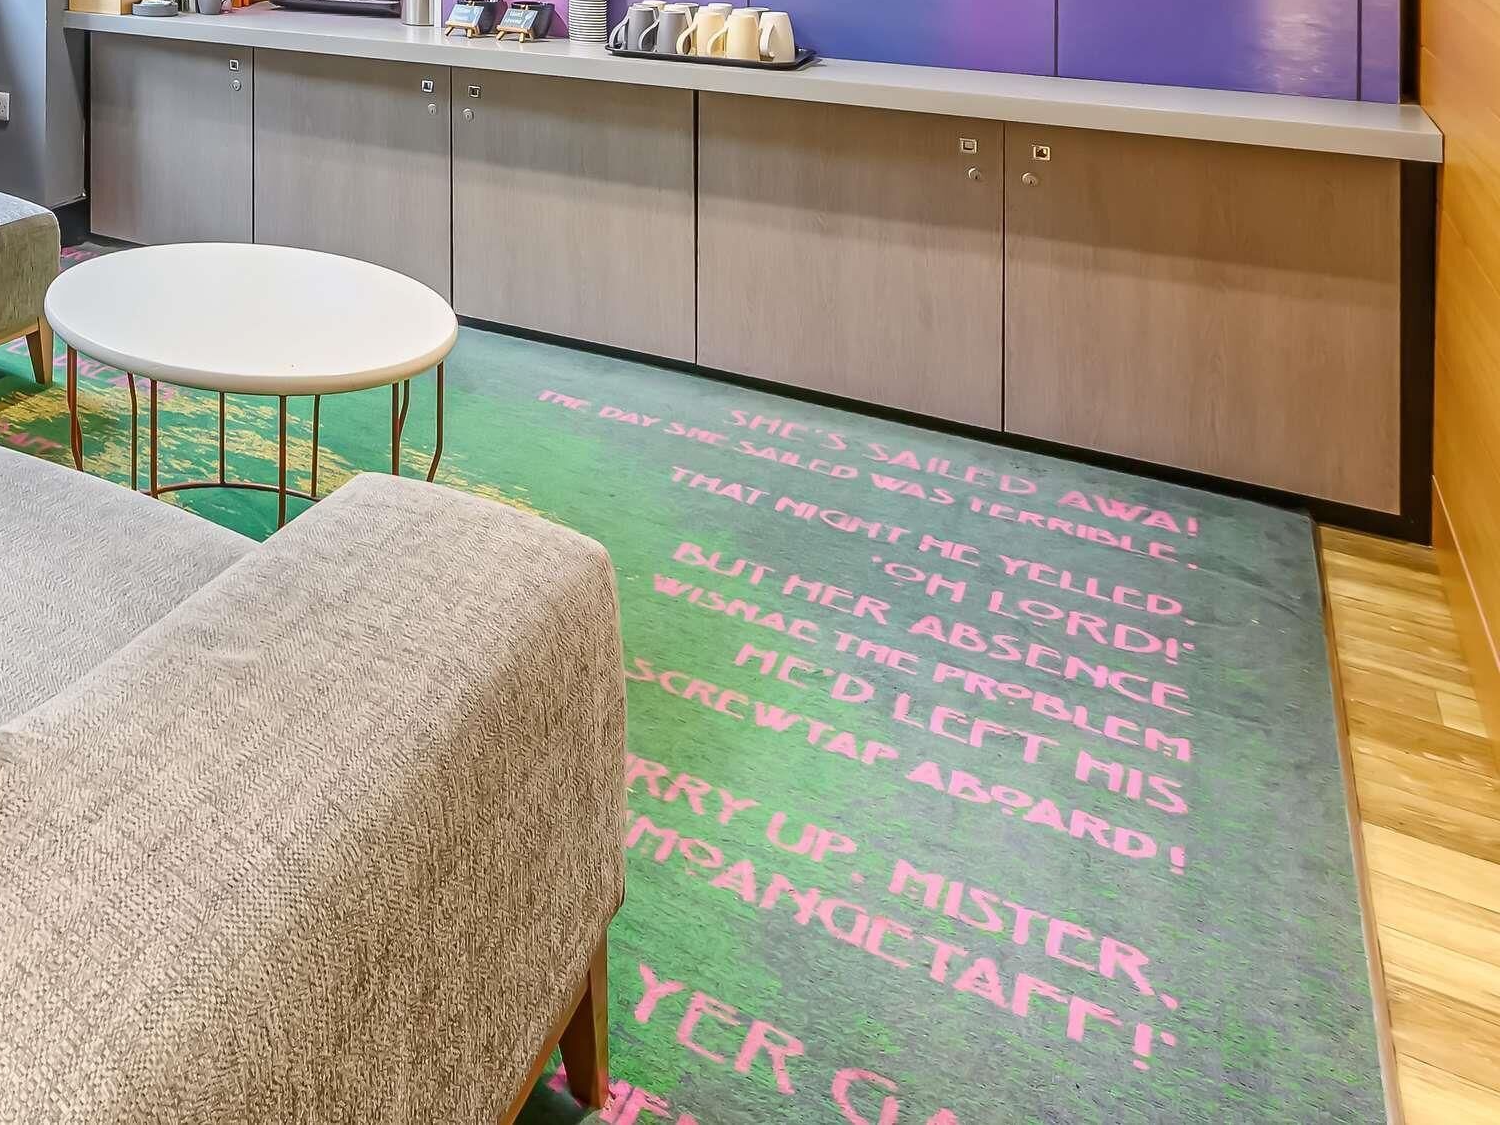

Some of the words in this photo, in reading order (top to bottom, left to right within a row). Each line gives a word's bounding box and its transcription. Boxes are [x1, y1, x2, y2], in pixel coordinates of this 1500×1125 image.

[537, 389, 591, 412] THE
[598, 406, 660, 427] DAY
[663, 422, 730, 447] SHE
[731, 440, 858, 479] SAILED
[870, 474, 955, 506] WAS
[723, 409, 848, 451] SHE'S
[862, 442, 1037, 496] SAILED
[1057, 491, 1198, 537] AWA!
[671, 465, 771, 506] THAT
[774, 496, 911, 544] NIGHT
[918, 534, 980, 567] HE
[671, 542, 777, 586] BUT
[782, 574, 891, 626] HER
[908, 615, 1194, 716] ABSENCE
[733, 643, 876, 704] HE'D
[892, 691, 1060, 765] LEFT
[1074, 750, 1189, 815] HIS
[834, 630, 921, 676] THE
[931, 661, 1193, 763] PROBLEM
[625, 657, 899, 766] SCREWTAP
[905, 760, 1186, 875] ABOARD!
[626, 752, 763, 825] RRY
[633, 963, 804, 1095] YER
